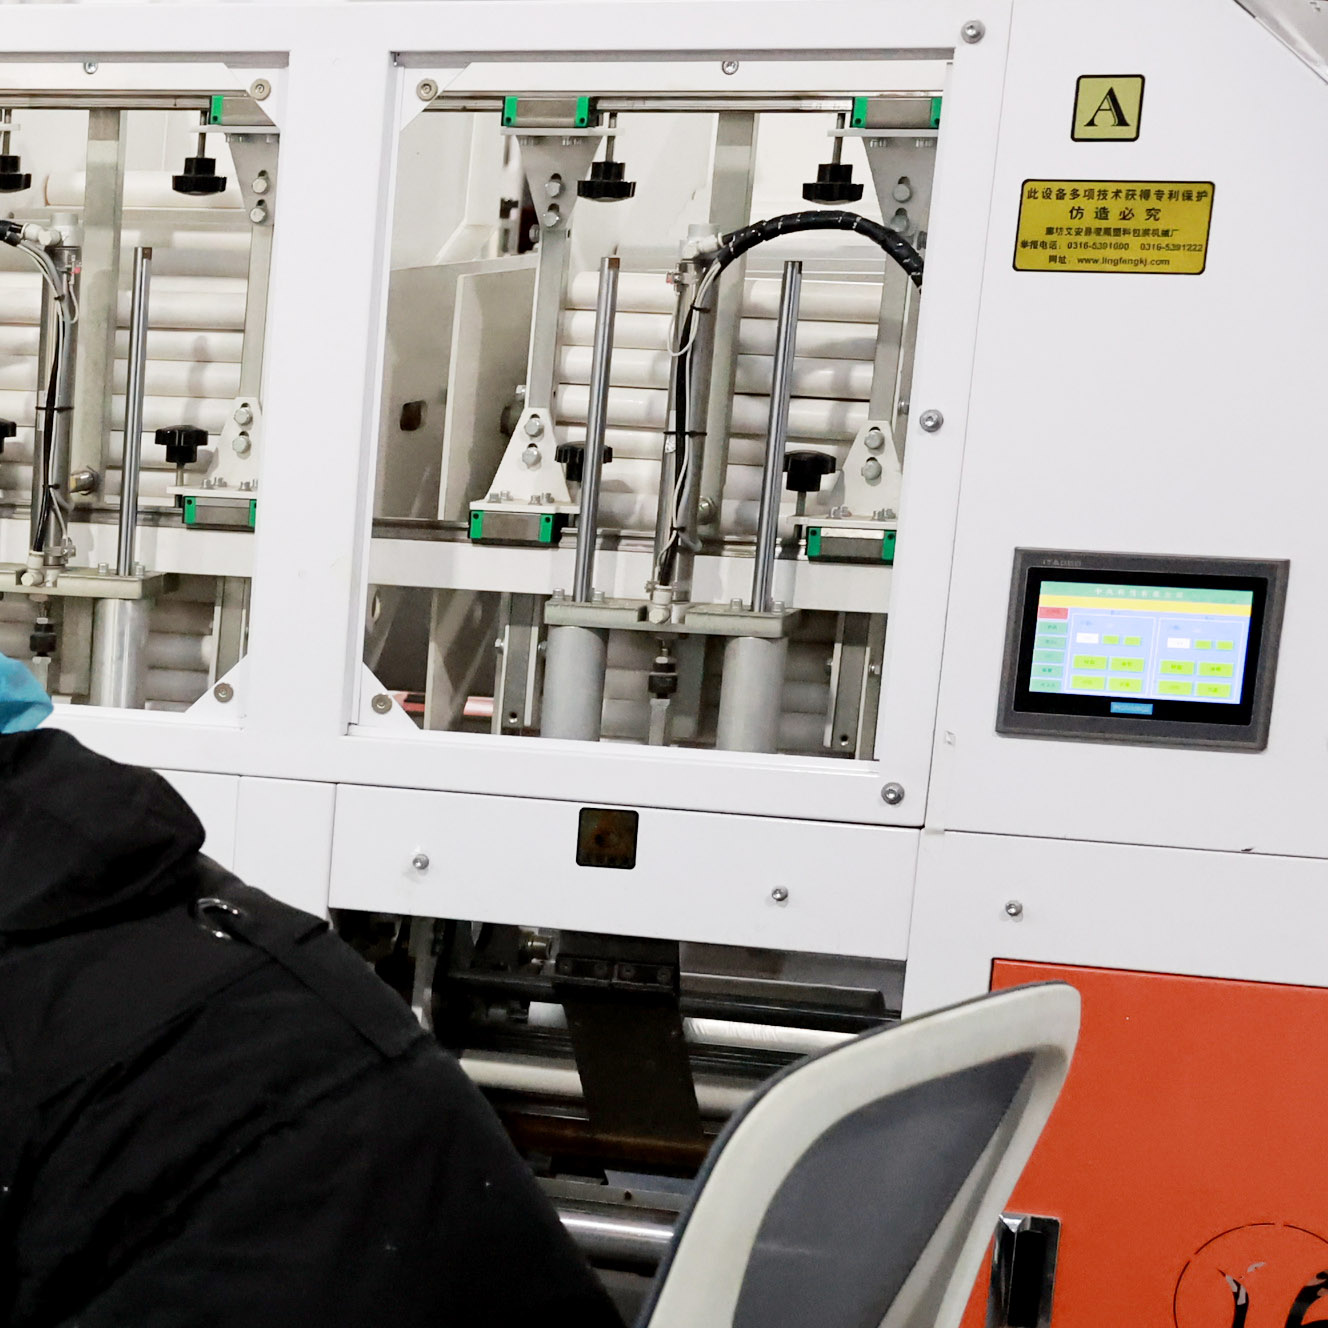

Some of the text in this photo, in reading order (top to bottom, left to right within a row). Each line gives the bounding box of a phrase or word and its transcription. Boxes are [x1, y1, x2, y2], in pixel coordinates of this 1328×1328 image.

[1083, 86, 1131, 128] A
[1026, 187, 1209, 203] 此设备多项技术获得专利保护
[1069, 206, 1162, 222] 仿造必究
